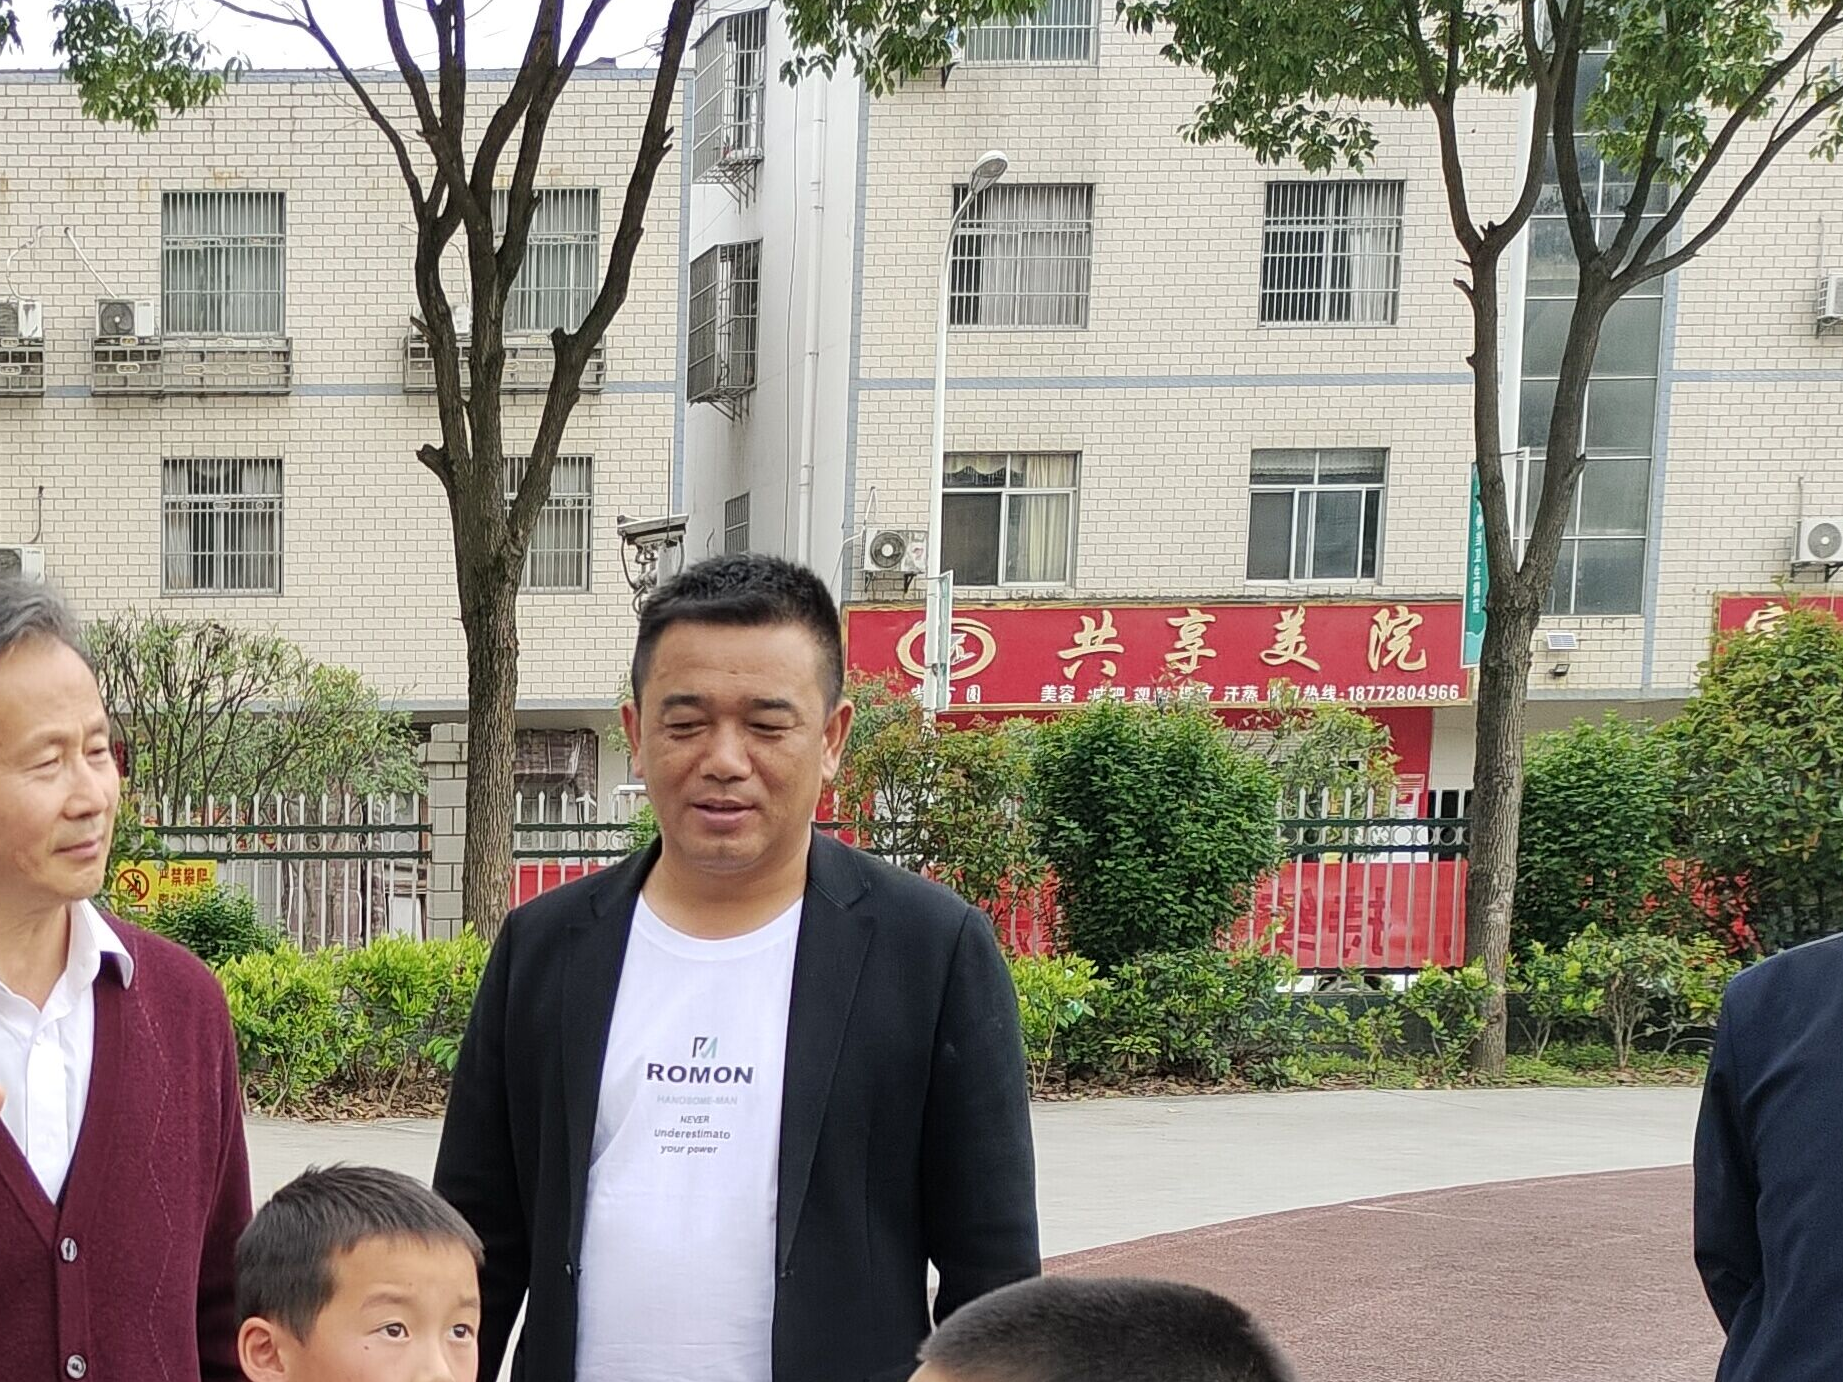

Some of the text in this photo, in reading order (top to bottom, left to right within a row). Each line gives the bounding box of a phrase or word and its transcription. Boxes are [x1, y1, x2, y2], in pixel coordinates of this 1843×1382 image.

[1057, 604, 1427, 680] 共享美院
[1040, 684, 1076, 703] 美容
[646, 1063, 754, 1084] ROMON
[680, 1115, 710, 1124] NEVER
[660, 1145, 685, 1154] your
